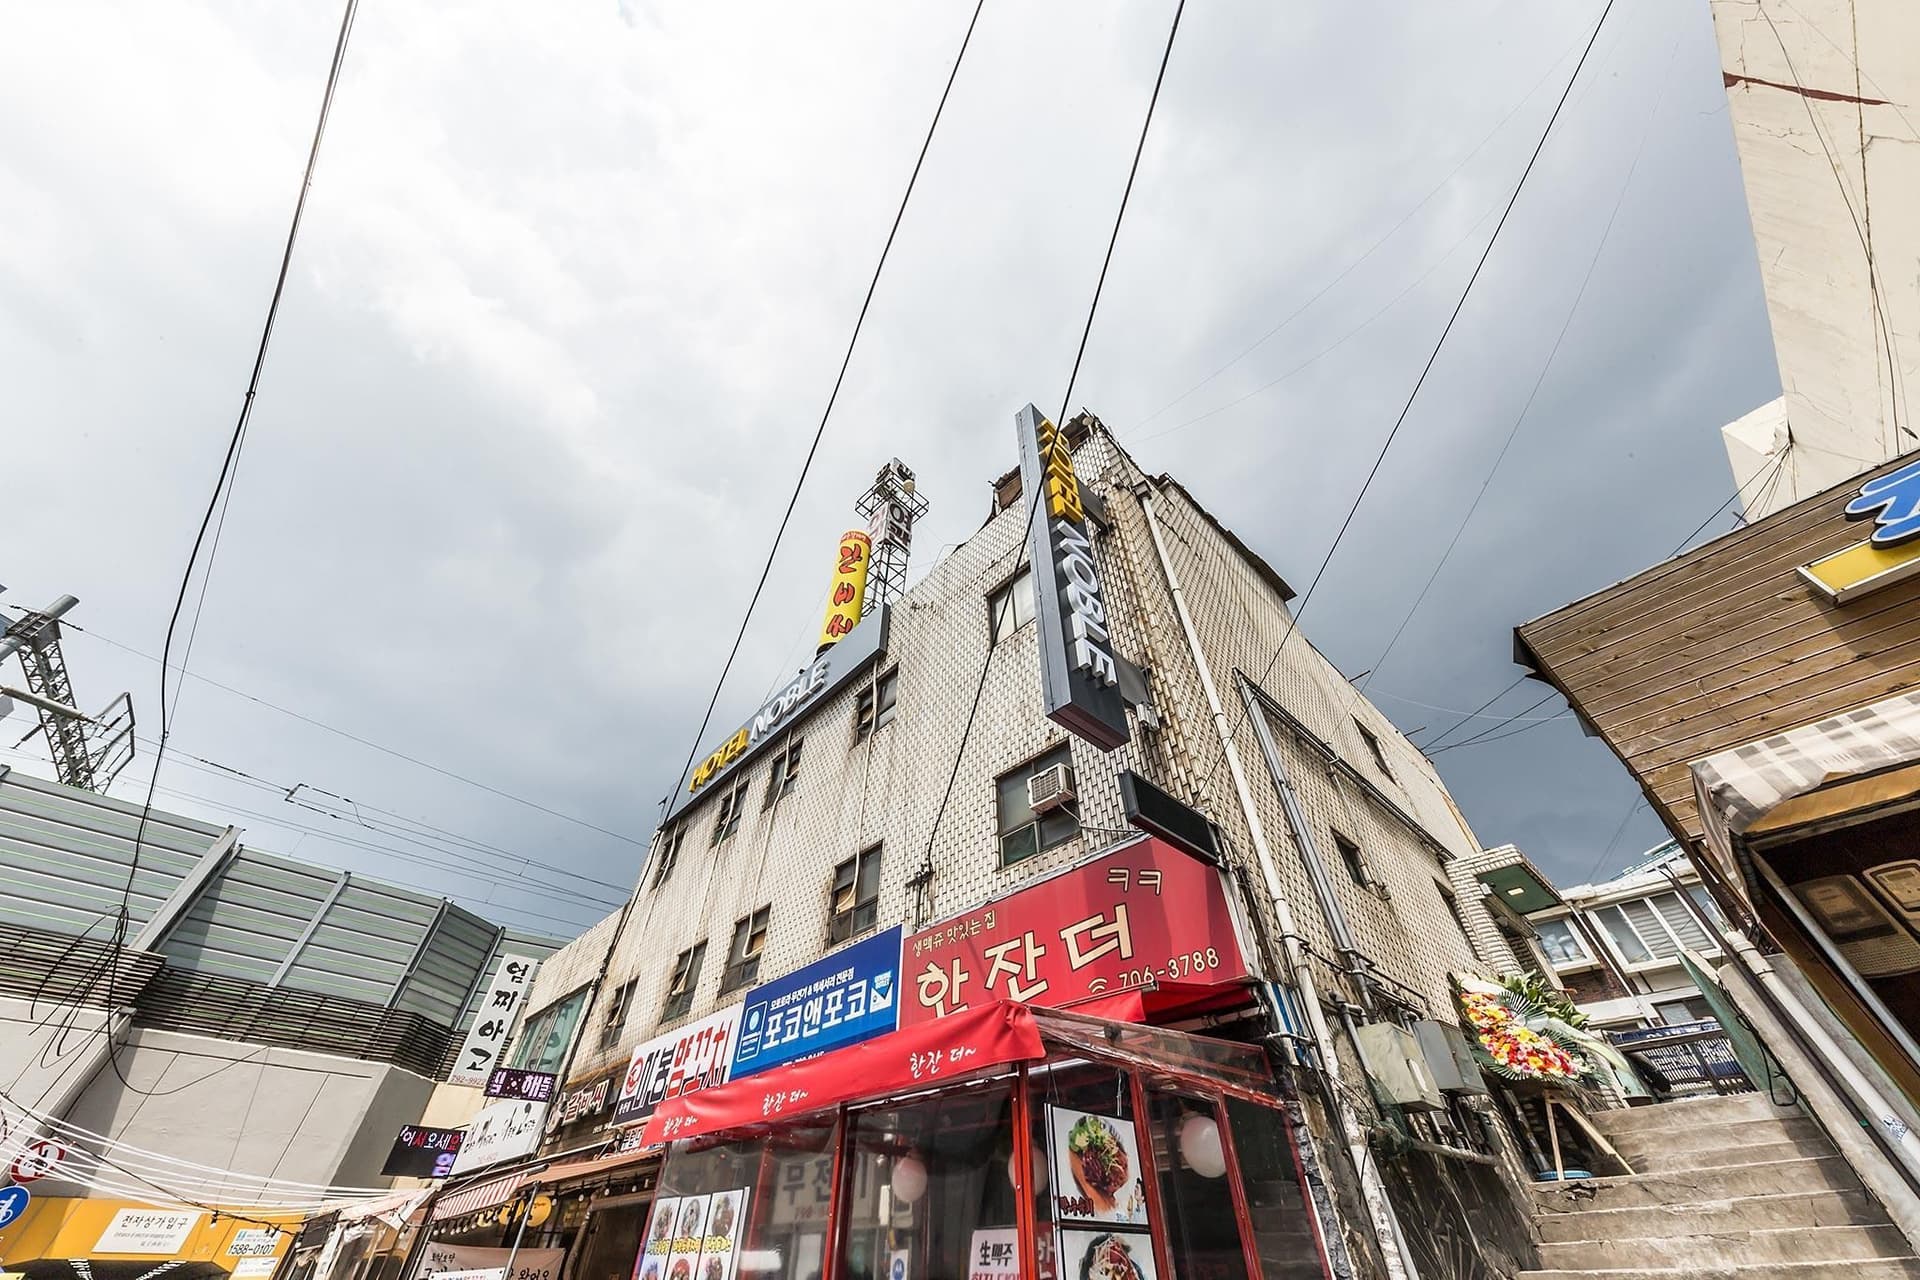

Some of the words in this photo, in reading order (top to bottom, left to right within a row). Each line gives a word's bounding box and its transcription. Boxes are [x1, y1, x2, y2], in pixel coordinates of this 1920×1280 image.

[1036, 418, 1084, 524] HOTEL
[1053, 519, 1119, 687] NOBLE
[688, 727, 749, 793] HOTEL
[750, 659, 830, 742] NOBLE
[1108, 867, 1162, 896] ㅋㅋ
[946, 919, 981, 944] 맛있는
[984, 910, 996, 930] 집
[1118, 946, 1220, 988] 706-3788
[762, 979, 868, 1050] 포코앤포코
[909, 1050, 943, 1079] 한잔
[228, 1244, 275, 1255] 1588-0107
